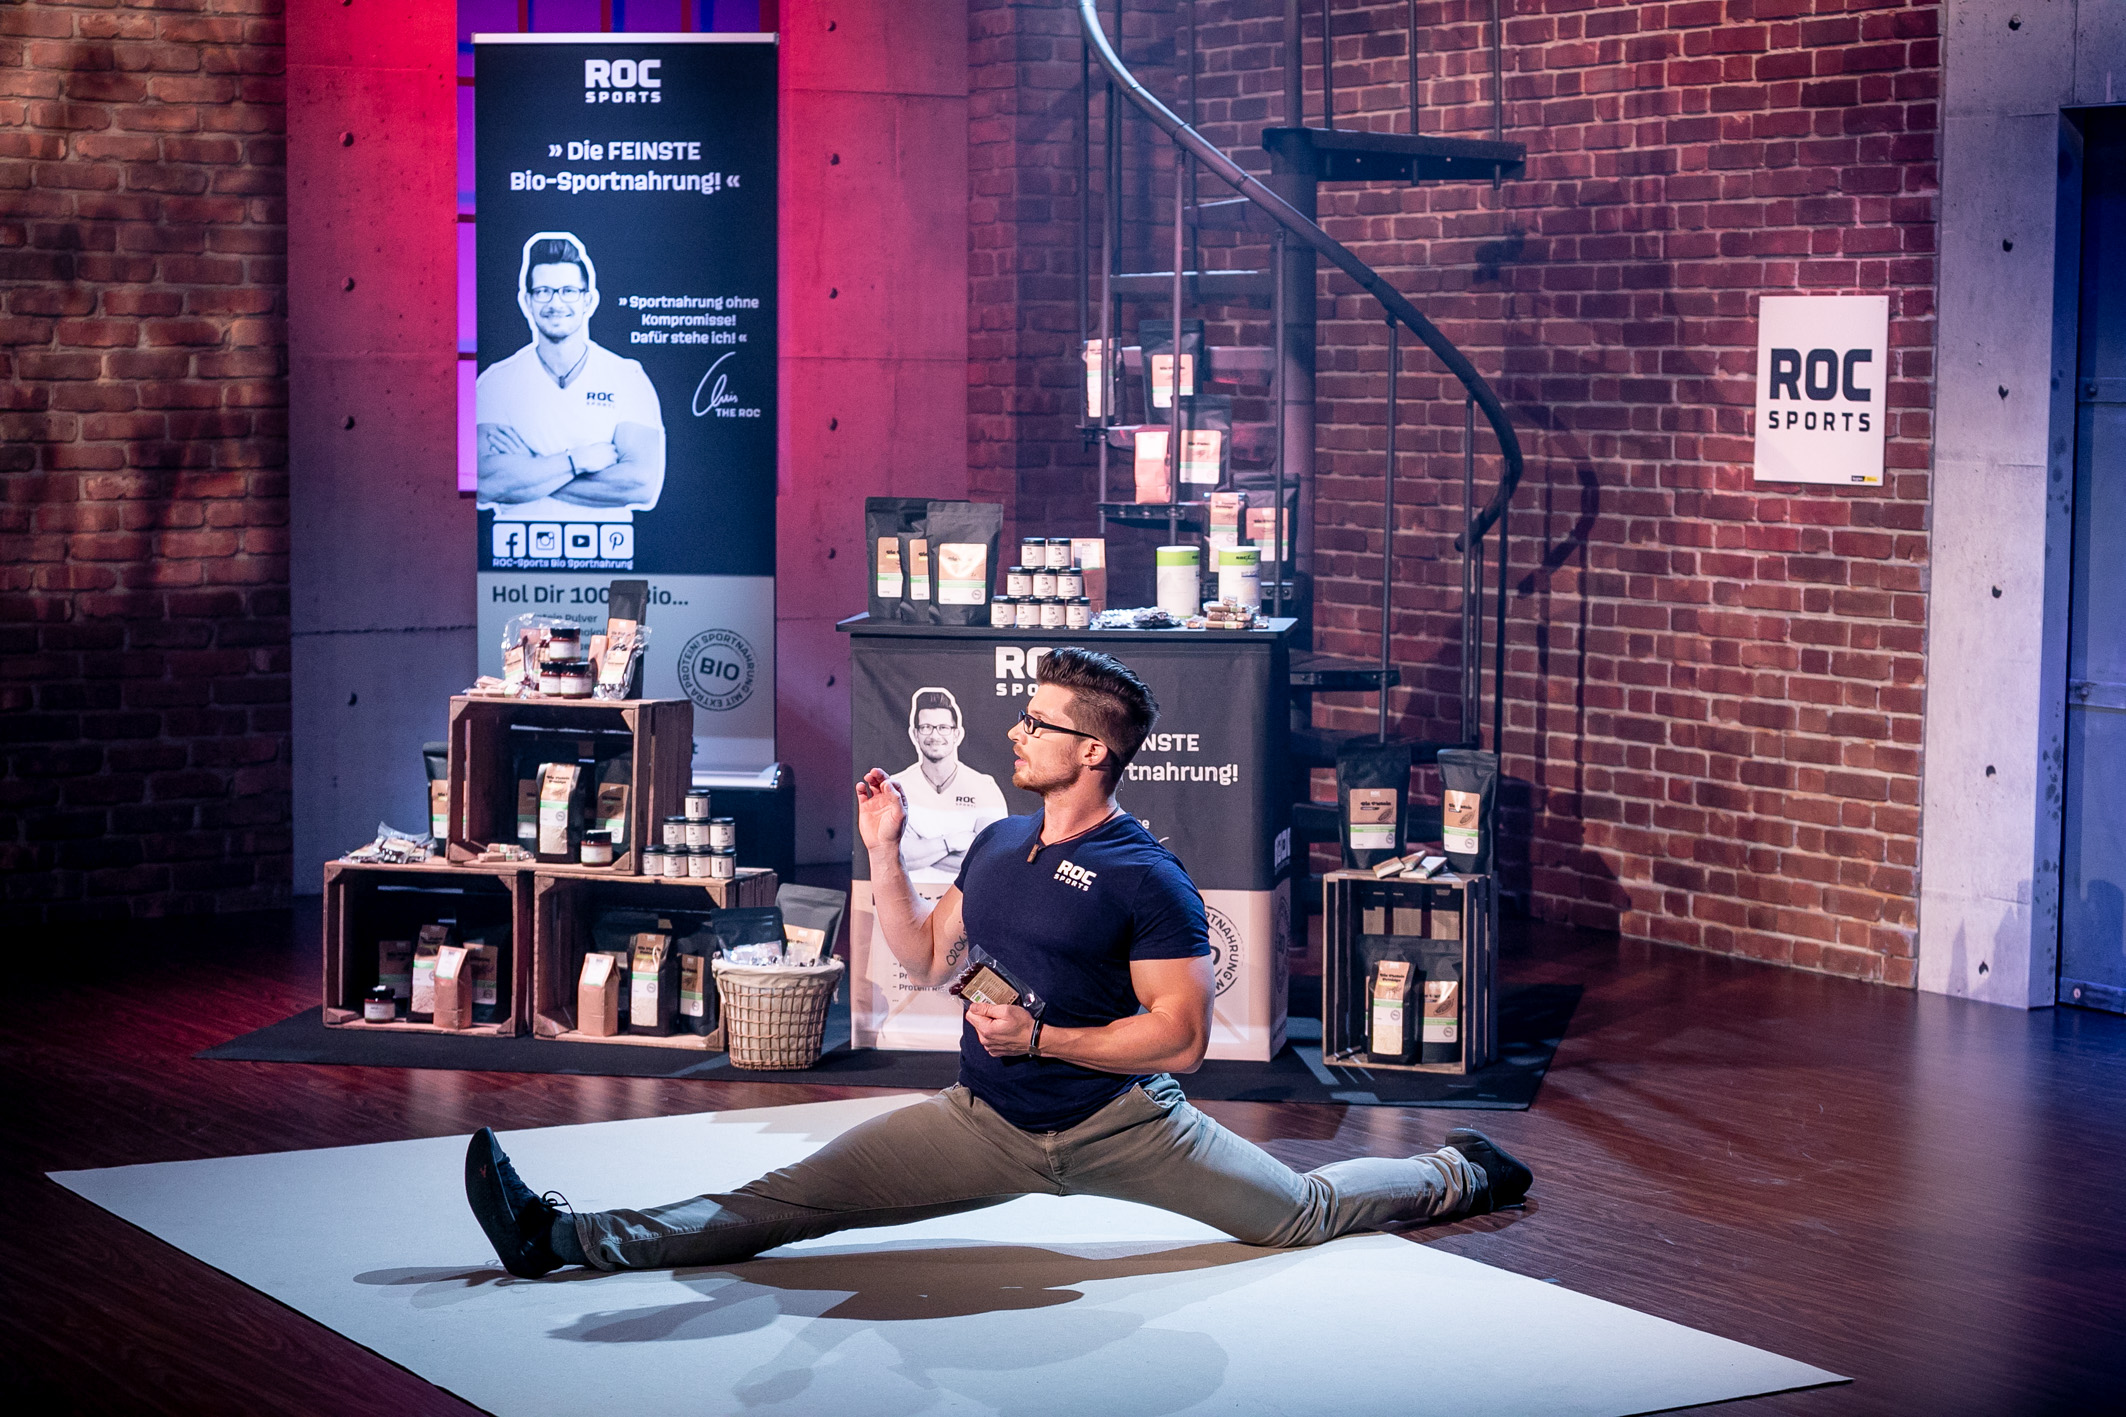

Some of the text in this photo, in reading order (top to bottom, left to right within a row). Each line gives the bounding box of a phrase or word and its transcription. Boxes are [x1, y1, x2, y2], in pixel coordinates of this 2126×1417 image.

[585, 59, 661, 88] ROC
[585, 91, 661, 103] SPORTS
[567, 139, 603, 160] Die
[608, 142, 701, 160] FEINSTE
[510, 170, 721, 195] Bio-Sportnahrung!
[629, 295, 724, 310] Sportnahrung
[725, 296, 759, 308] ohne
[641, 313, 737, 328] Kompromisse!
[630, 331, 669, 344] Dafür
[670, 331, 709, 344] stehe
[711, 331, 736, 344] ich!
[1769, 348, 1872, 402] ROC
[586, 392, 615, 402] ROC
[715, 408, 761, 417] THE ROC
[1769, 411, 1871, 432] SPORTS
[492, 585, 529, 603] Hol
[534, 585, 565, 603] Dir
[570, 586, 611, 604] 100
[565, 613, 598, 623] Pulver
[700, 657, 740, 681] BIO
[701, 632, 755, 693] SPORTNAHRUNG
[995, 683, 1039, 696] SPO
[1141, 733, 1200, 752] NSTE
[956, 796, 976, 804] ROC
[1056, 859, 1097, 886] ROC
[1053, 873, 1089, 892] SPORTS
